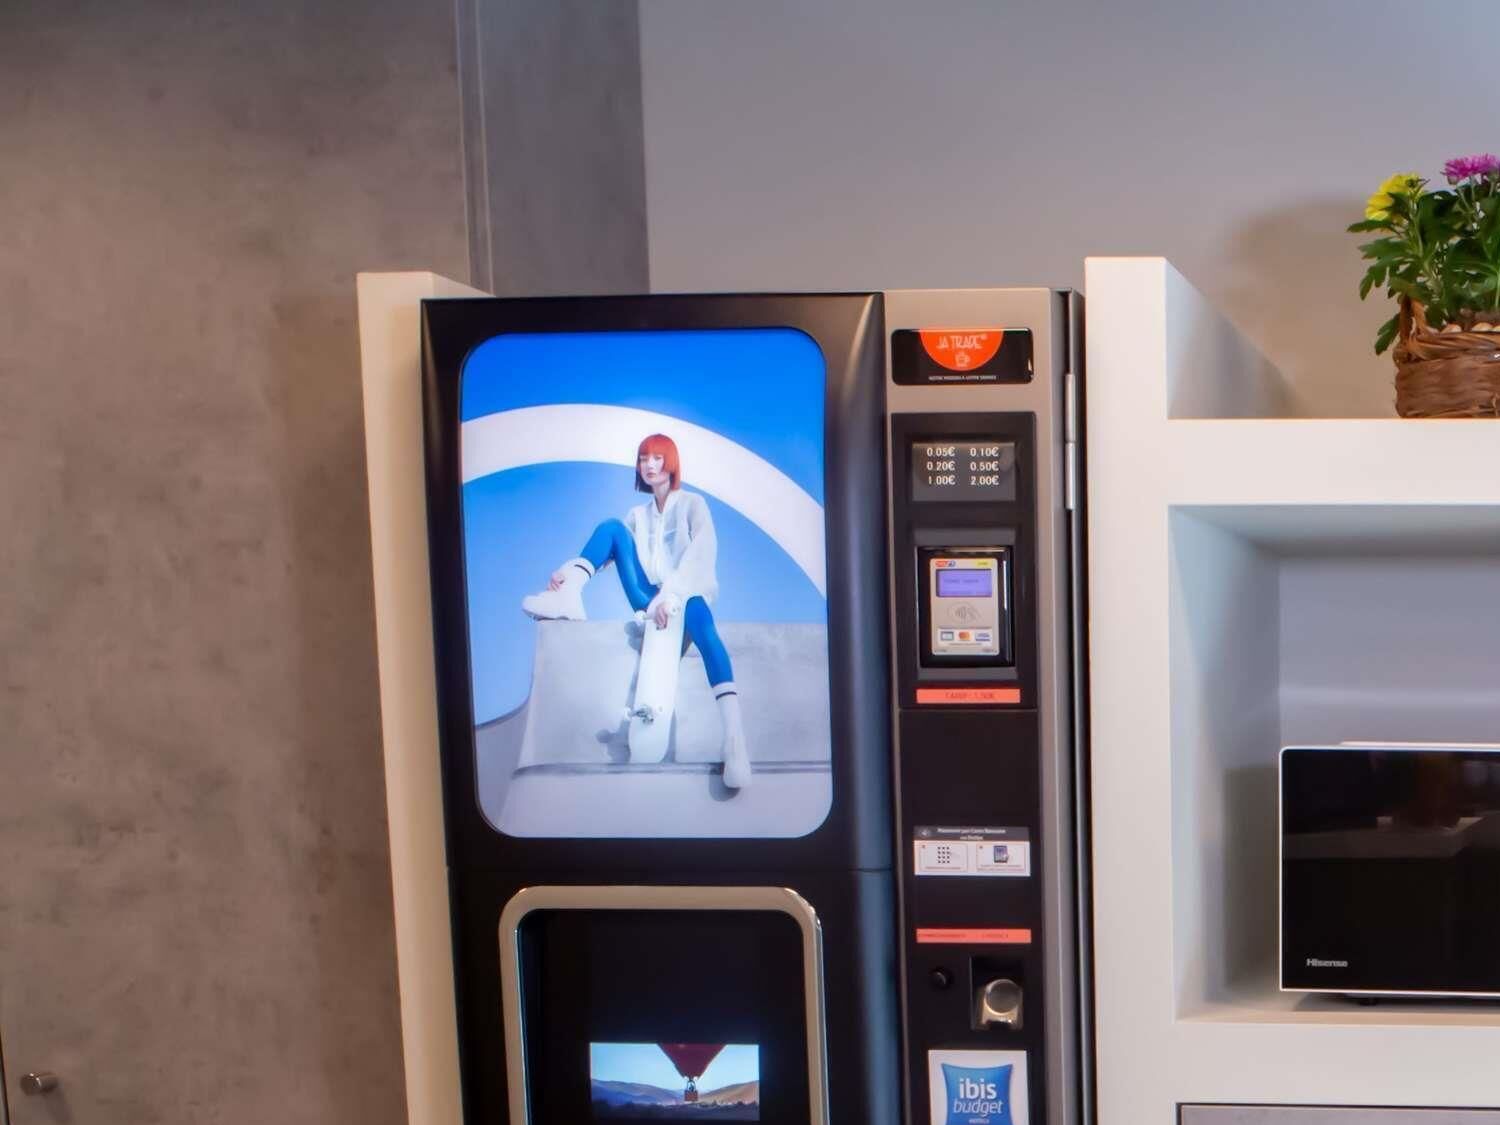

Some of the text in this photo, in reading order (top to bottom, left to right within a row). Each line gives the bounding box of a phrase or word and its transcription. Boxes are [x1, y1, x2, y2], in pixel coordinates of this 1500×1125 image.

[970, 446, 1000, 457] 0.10€
[970, 460, 1000, 471] 0.50€
[970, 474, 1000, 485] 2.00€
[959, 1078, 998, 1100] ibis
[953, 1099, 1004, 1118] budget
